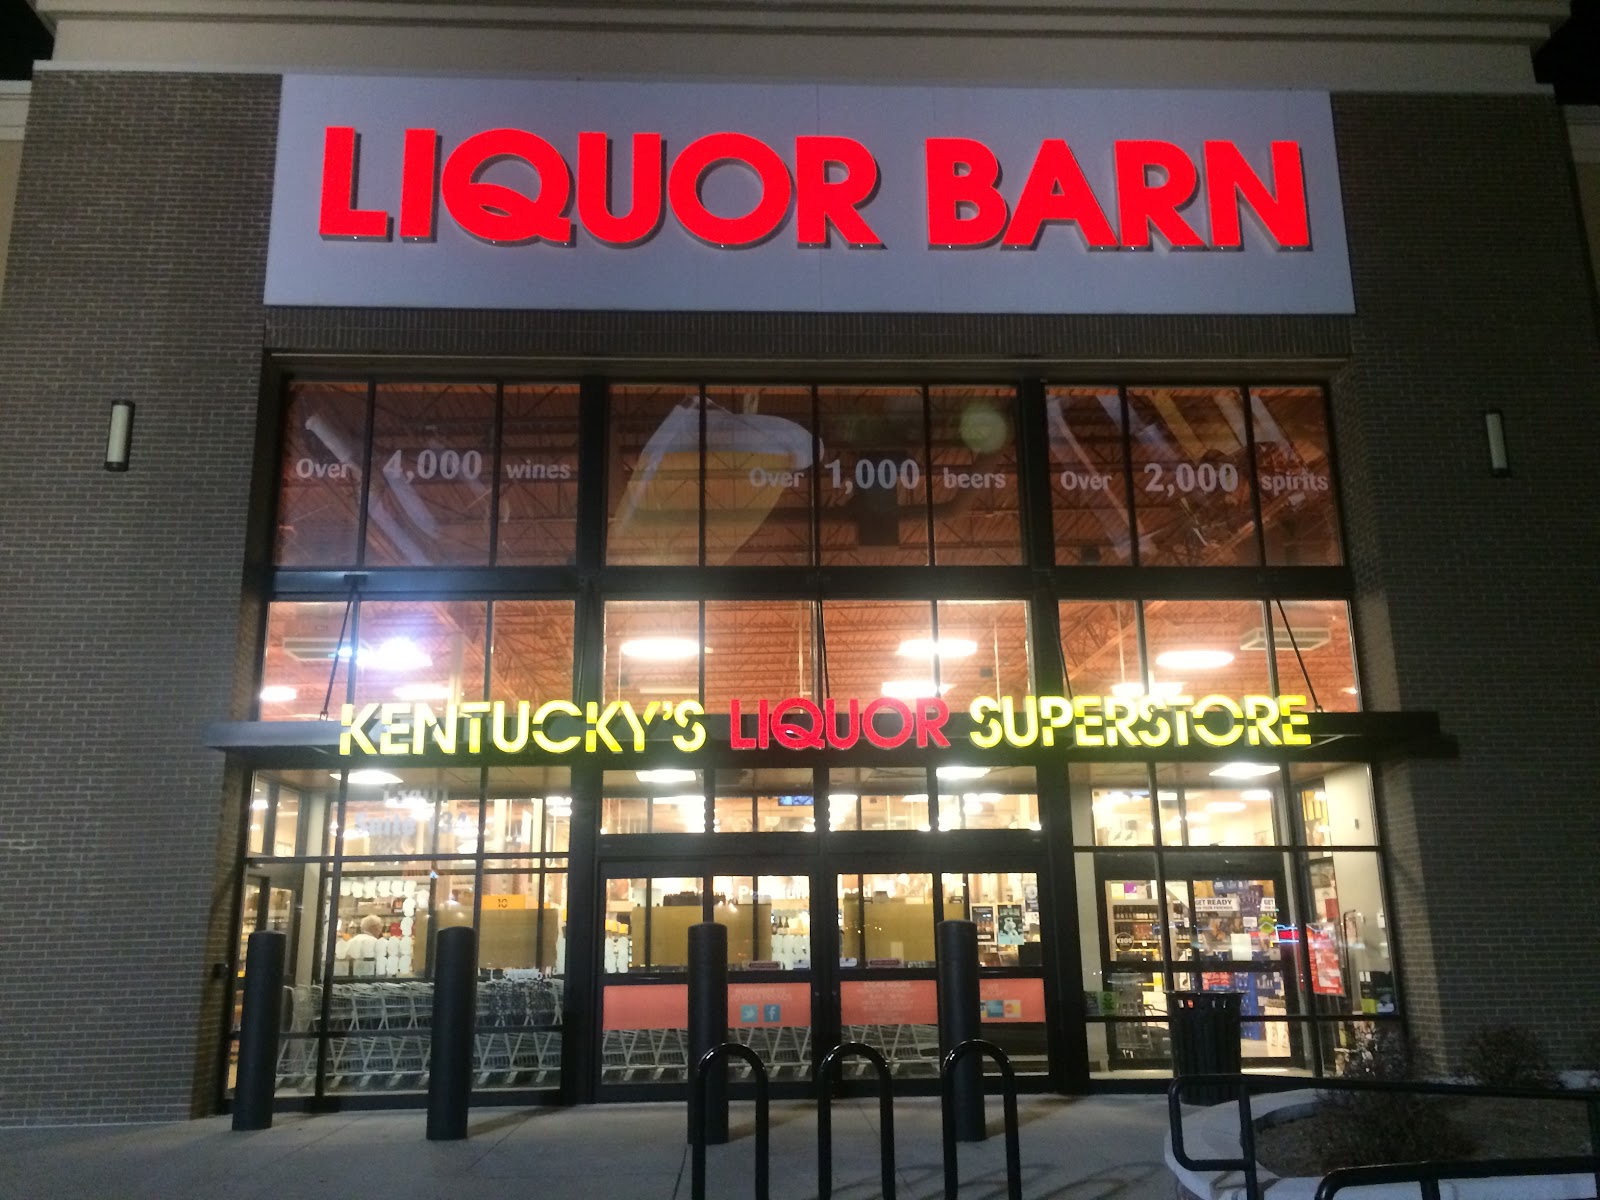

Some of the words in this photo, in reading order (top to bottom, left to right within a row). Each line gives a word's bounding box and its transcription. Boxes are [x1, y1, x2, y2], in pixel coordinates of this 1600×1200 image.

[319, 126, 882, 246] LIQUOR
[926, 137, 1309, 249] BARN
[295, 457, 350, 479] Over
[383, 449, 483, 484] 4,000
[506, 459, 571, 479] wines
[749, 467, 805, 489] Over
[824, 459, 920, 495] 1,000
[943, 467, 1007, 489] beers
[1060, 470, 1113, 491] Over
[1143, 462, 1239, 497] 2,000
[1260, 468, 1330, 496] spirits
[340, 699, 706, 755] KENTUCKY'S
[730, 698, 948, 749] LIQUOR
[969, 694, 1312, 748] SUPERSTORE
